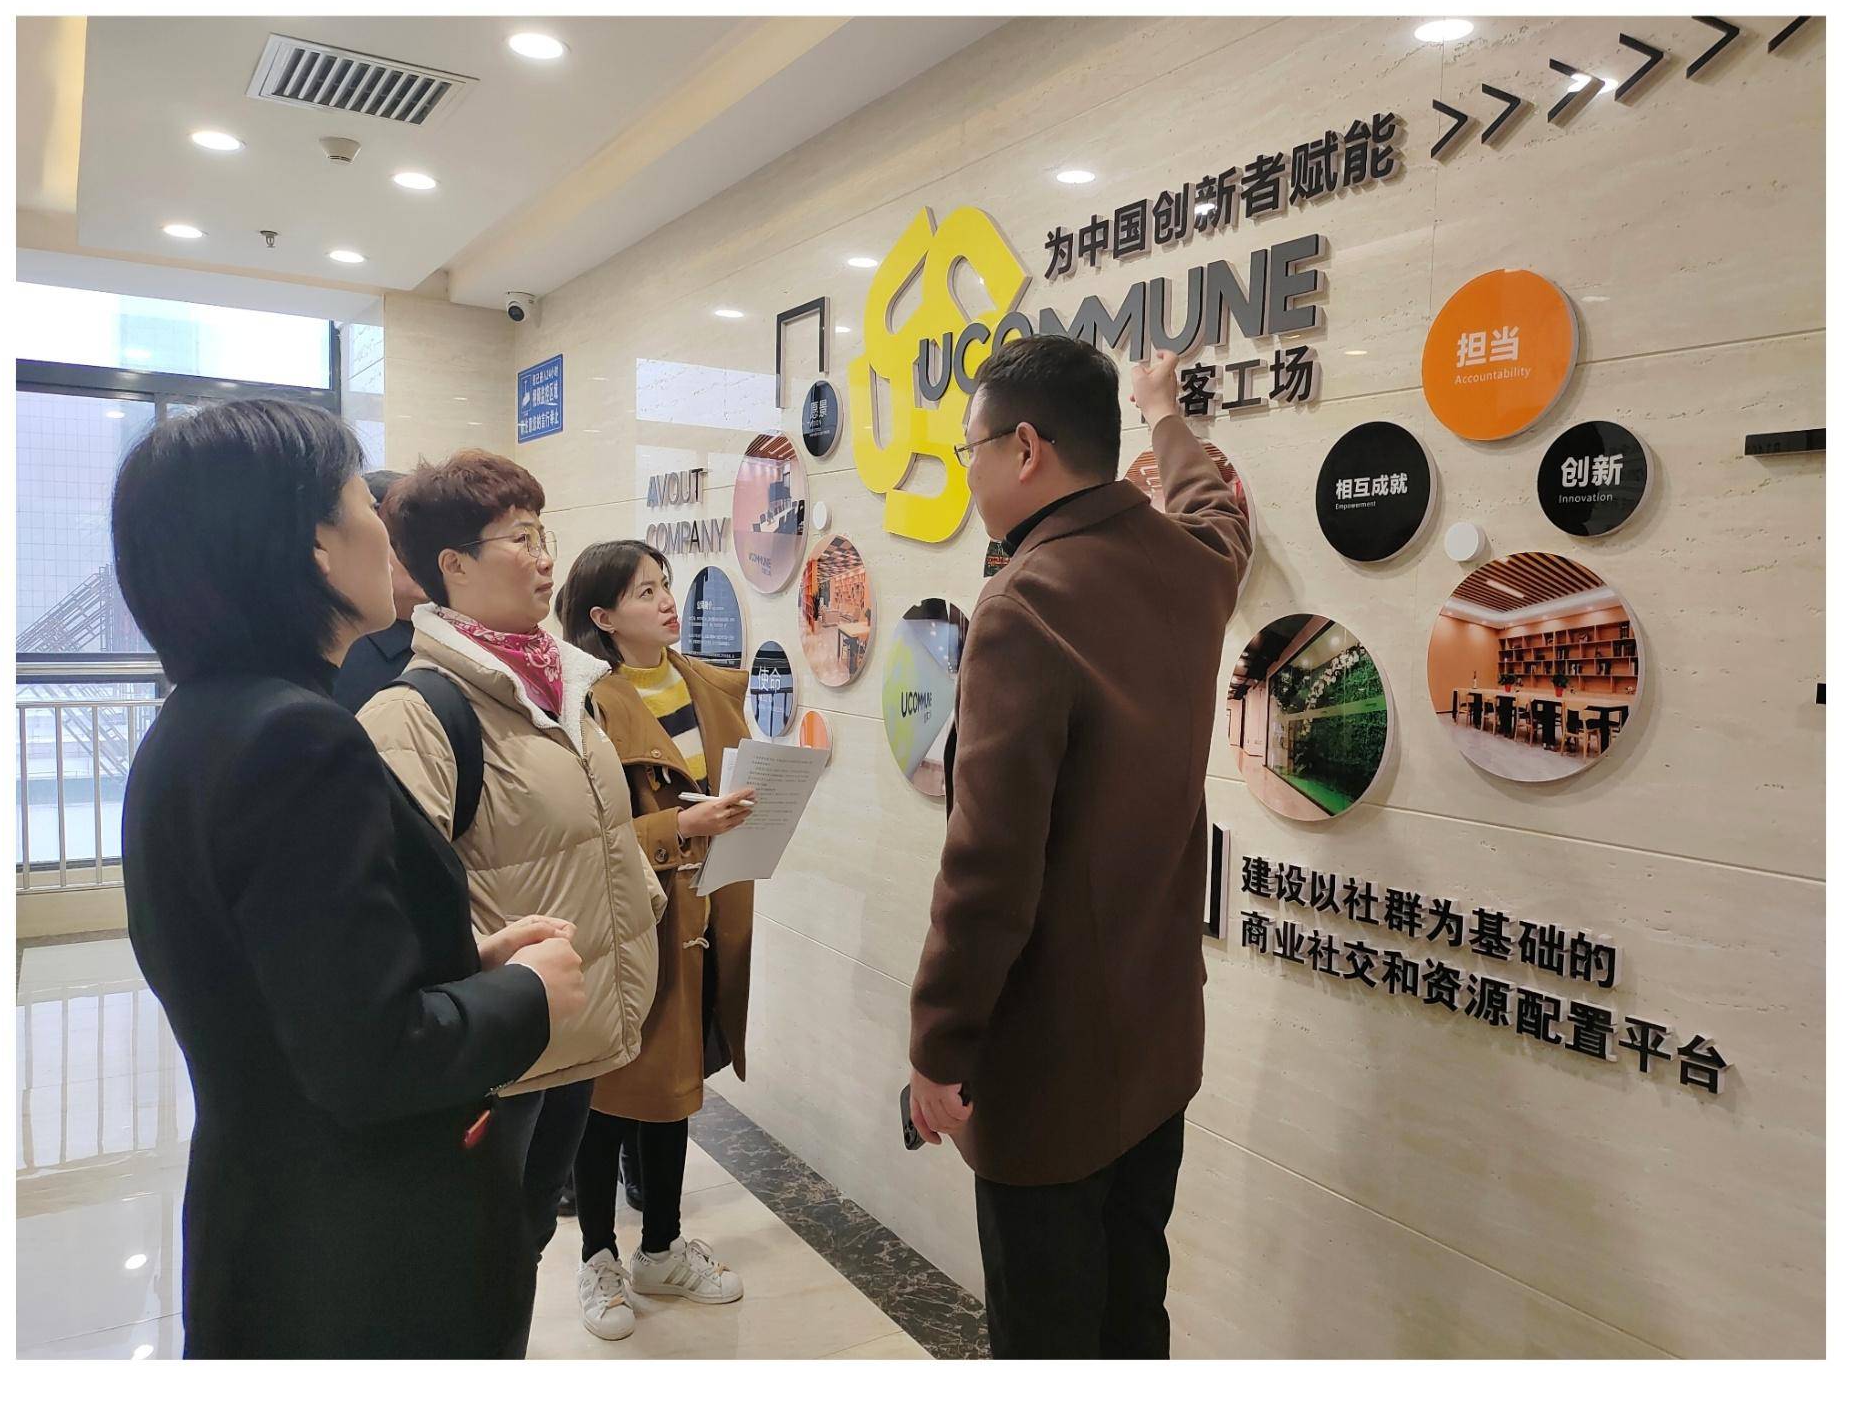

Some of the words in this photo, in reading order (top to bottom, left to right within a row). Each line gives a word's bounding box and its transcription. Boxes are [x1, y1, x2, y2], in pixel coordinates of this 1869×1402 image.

[1045, 112, 1398, 280] 为中国创新者赋能
[1456, 325, 1520, 368] 担当
[1179, 345, 1314, 417] 客工场
[1454, 366, 1531, 385] Accountability
[1335, 472, 1408, 500] 相互成就
[1560, 453, 1624, 488] 创新
[1335, 500, 1376, 511] Empowerment
[1558, 492, 1613, 504] Innovation
[646, 517, 730, 554] COMPANY
[759, 665, 782, 693] 使命
[1240, 855, 1620, 989] 建设以社群为基础的
[1239, 910, 1730, 1096] 商业社交和资源配置平台
